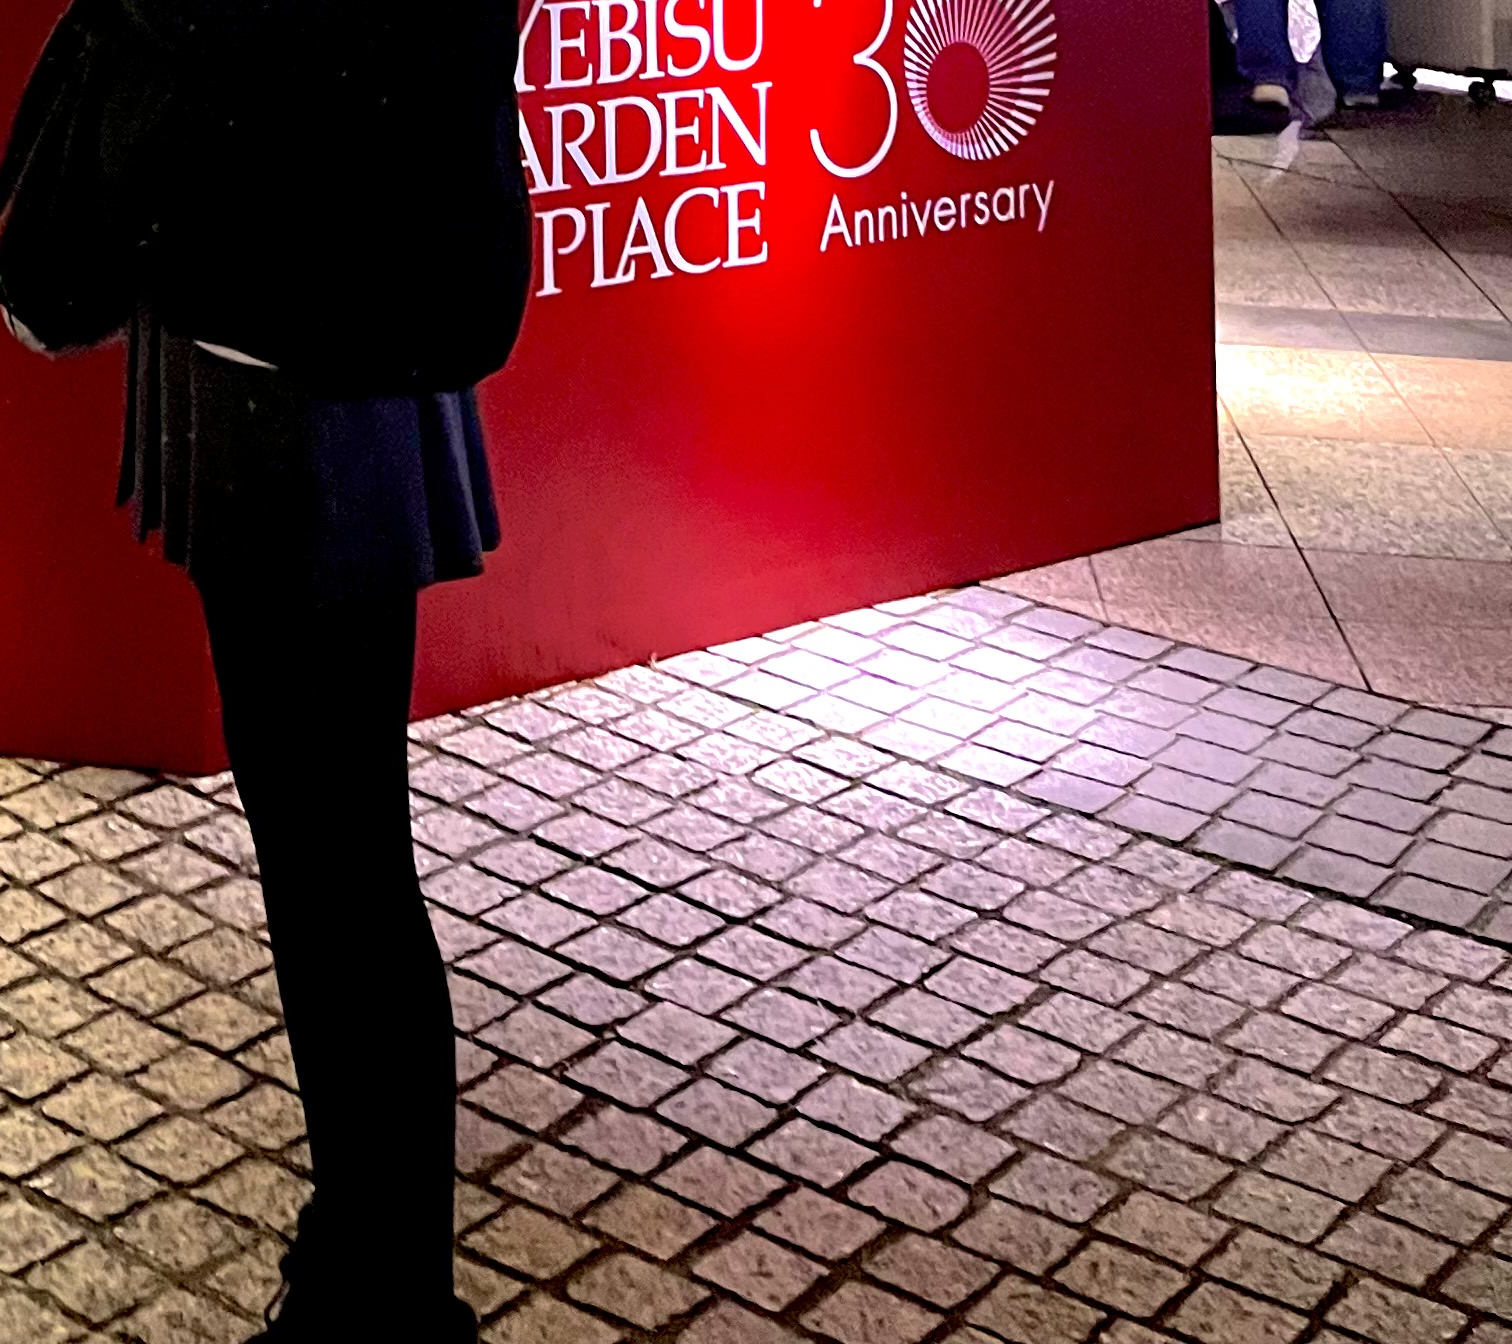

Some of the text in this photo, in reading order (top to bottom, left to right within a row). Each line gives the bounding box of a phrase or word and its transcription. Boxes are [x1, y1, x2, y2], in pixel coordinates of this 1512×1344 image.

[519, 82, 772, 194] ARDEN
[535, 181, 769, 297] PLACE
[820, 180, 1055, 252] Anniversary
